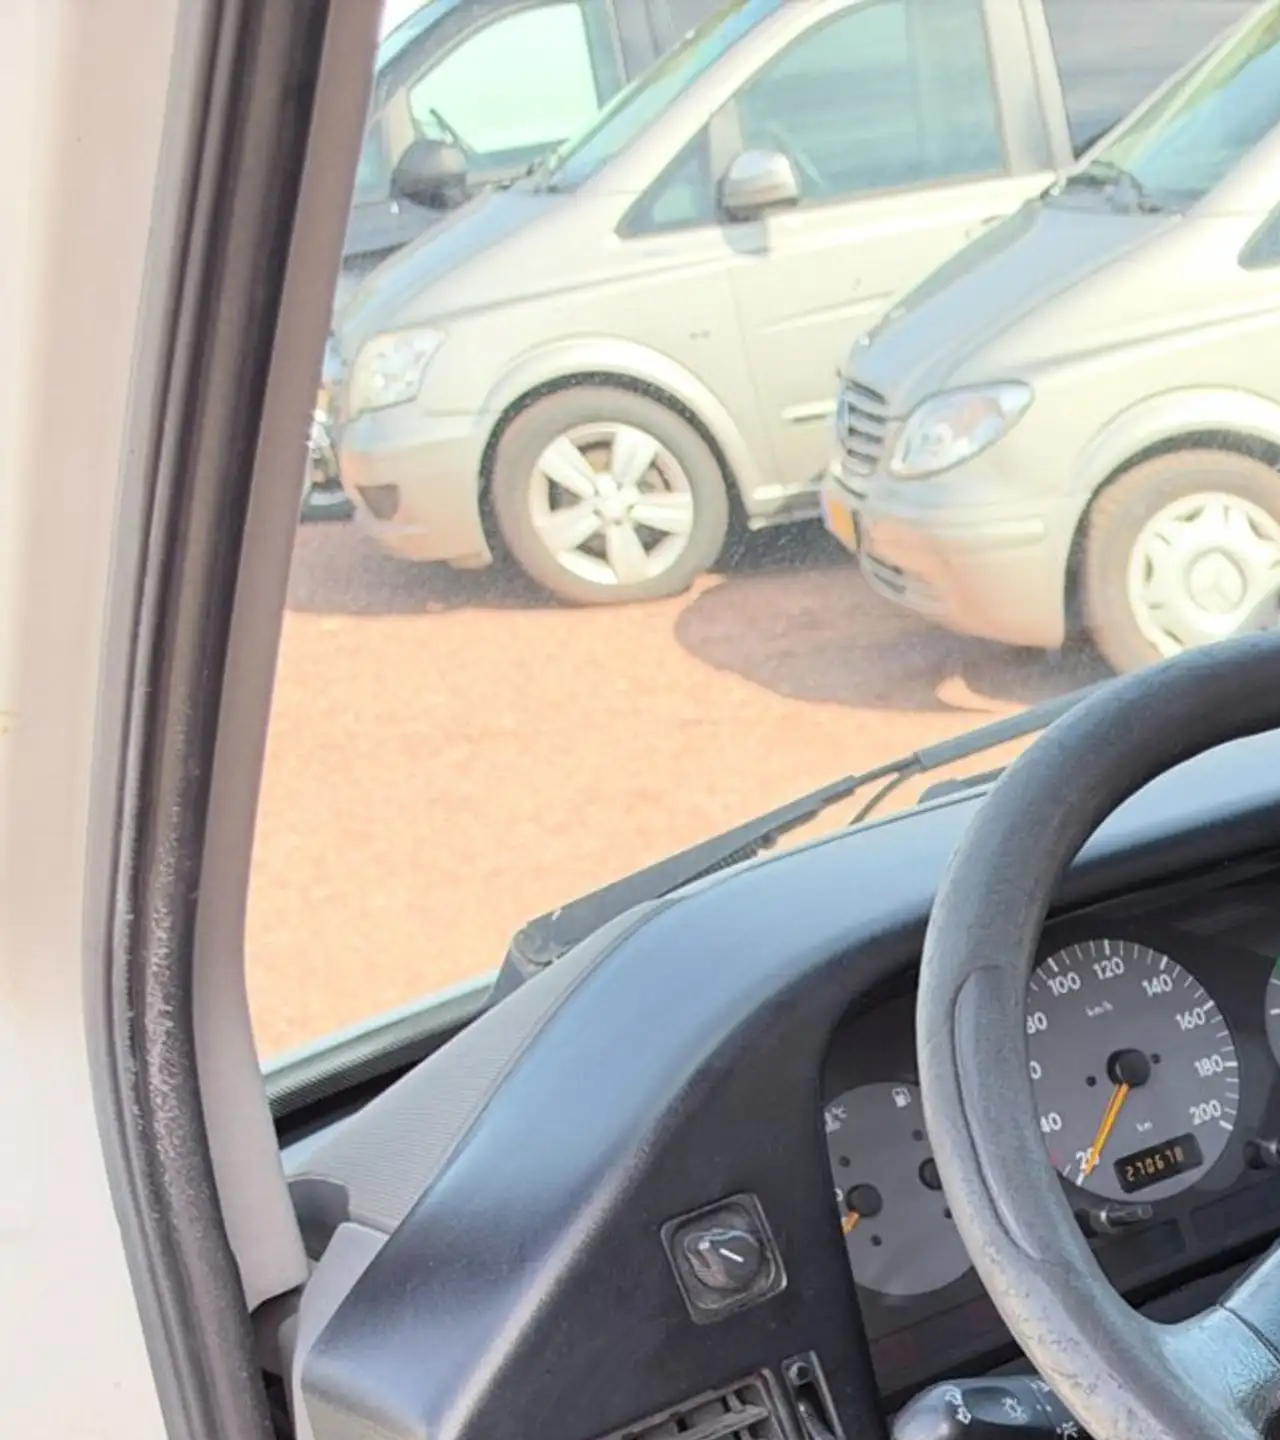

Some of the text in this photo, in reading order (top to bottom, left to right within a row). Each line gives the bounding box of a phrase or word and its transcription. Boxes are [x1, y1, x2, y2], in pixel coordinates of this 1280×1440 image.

[1093, 957, 1124, 979] 120
[1048, 972, 1081, 996] 100
[1142, 973, 1173, 997] 140
[1175, 1008, 1205, 1030] 160
[1194, 1055, 1223, 1077] 180
[1189, 1099, 1221, 1126] 200
